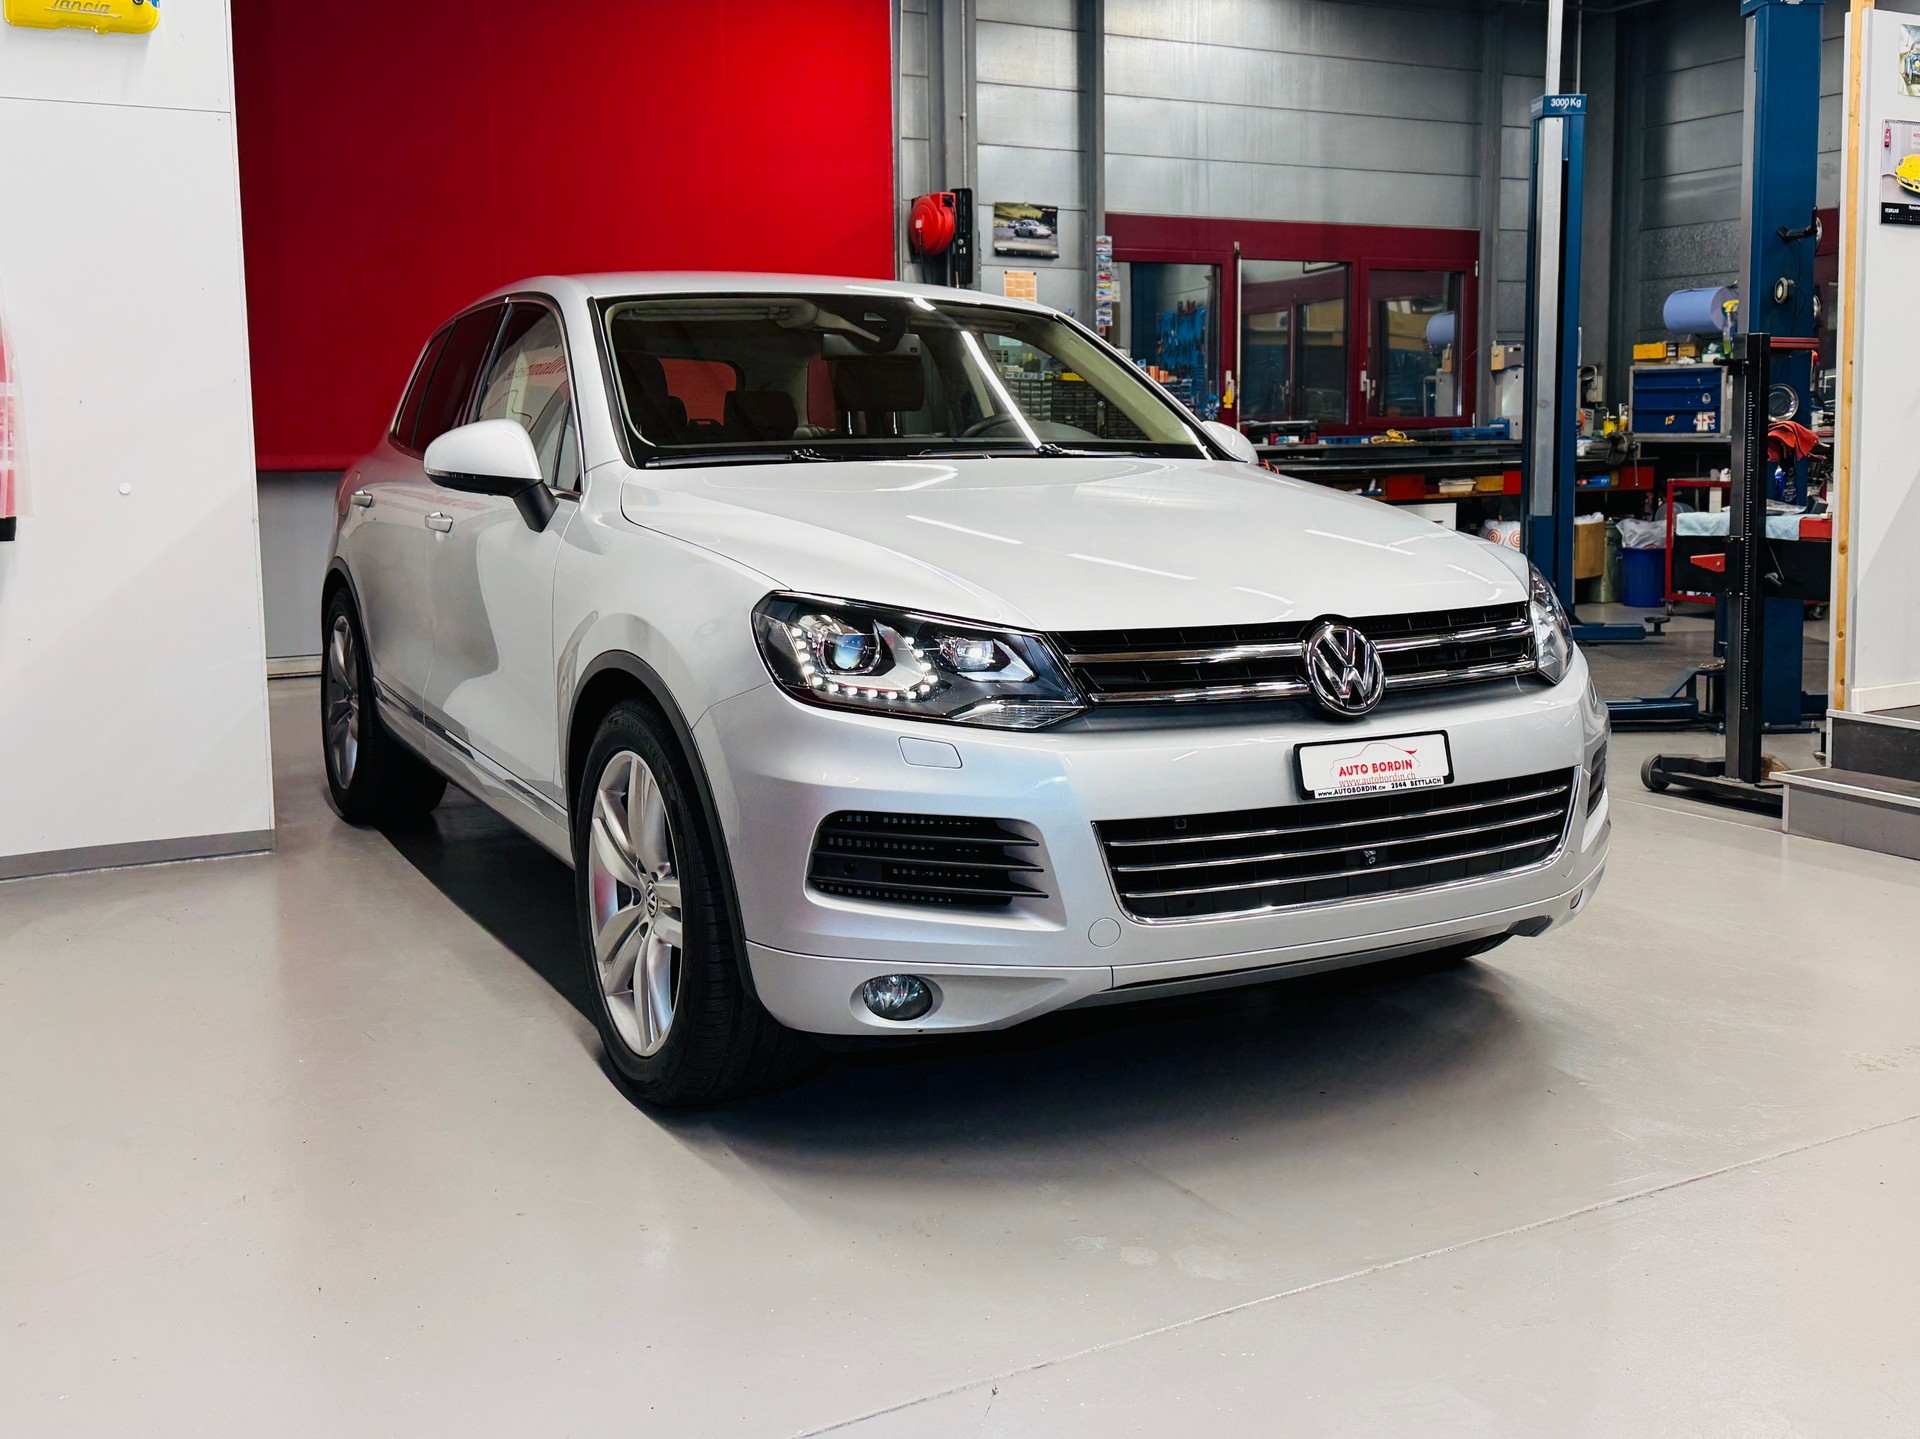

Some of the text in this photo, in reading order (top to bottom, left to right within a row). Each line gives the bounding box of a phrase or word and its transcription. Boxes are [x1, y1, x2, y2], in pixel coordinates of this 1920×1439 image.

[1550, 97, 1582, 108] 3000 Kg
[1339, 759, 1413, 777] AUTO BORDIN
[1338, 771, 1416, 788] www.autobordin.ch
[1410, 778, 1442, 787] BETTLACH
